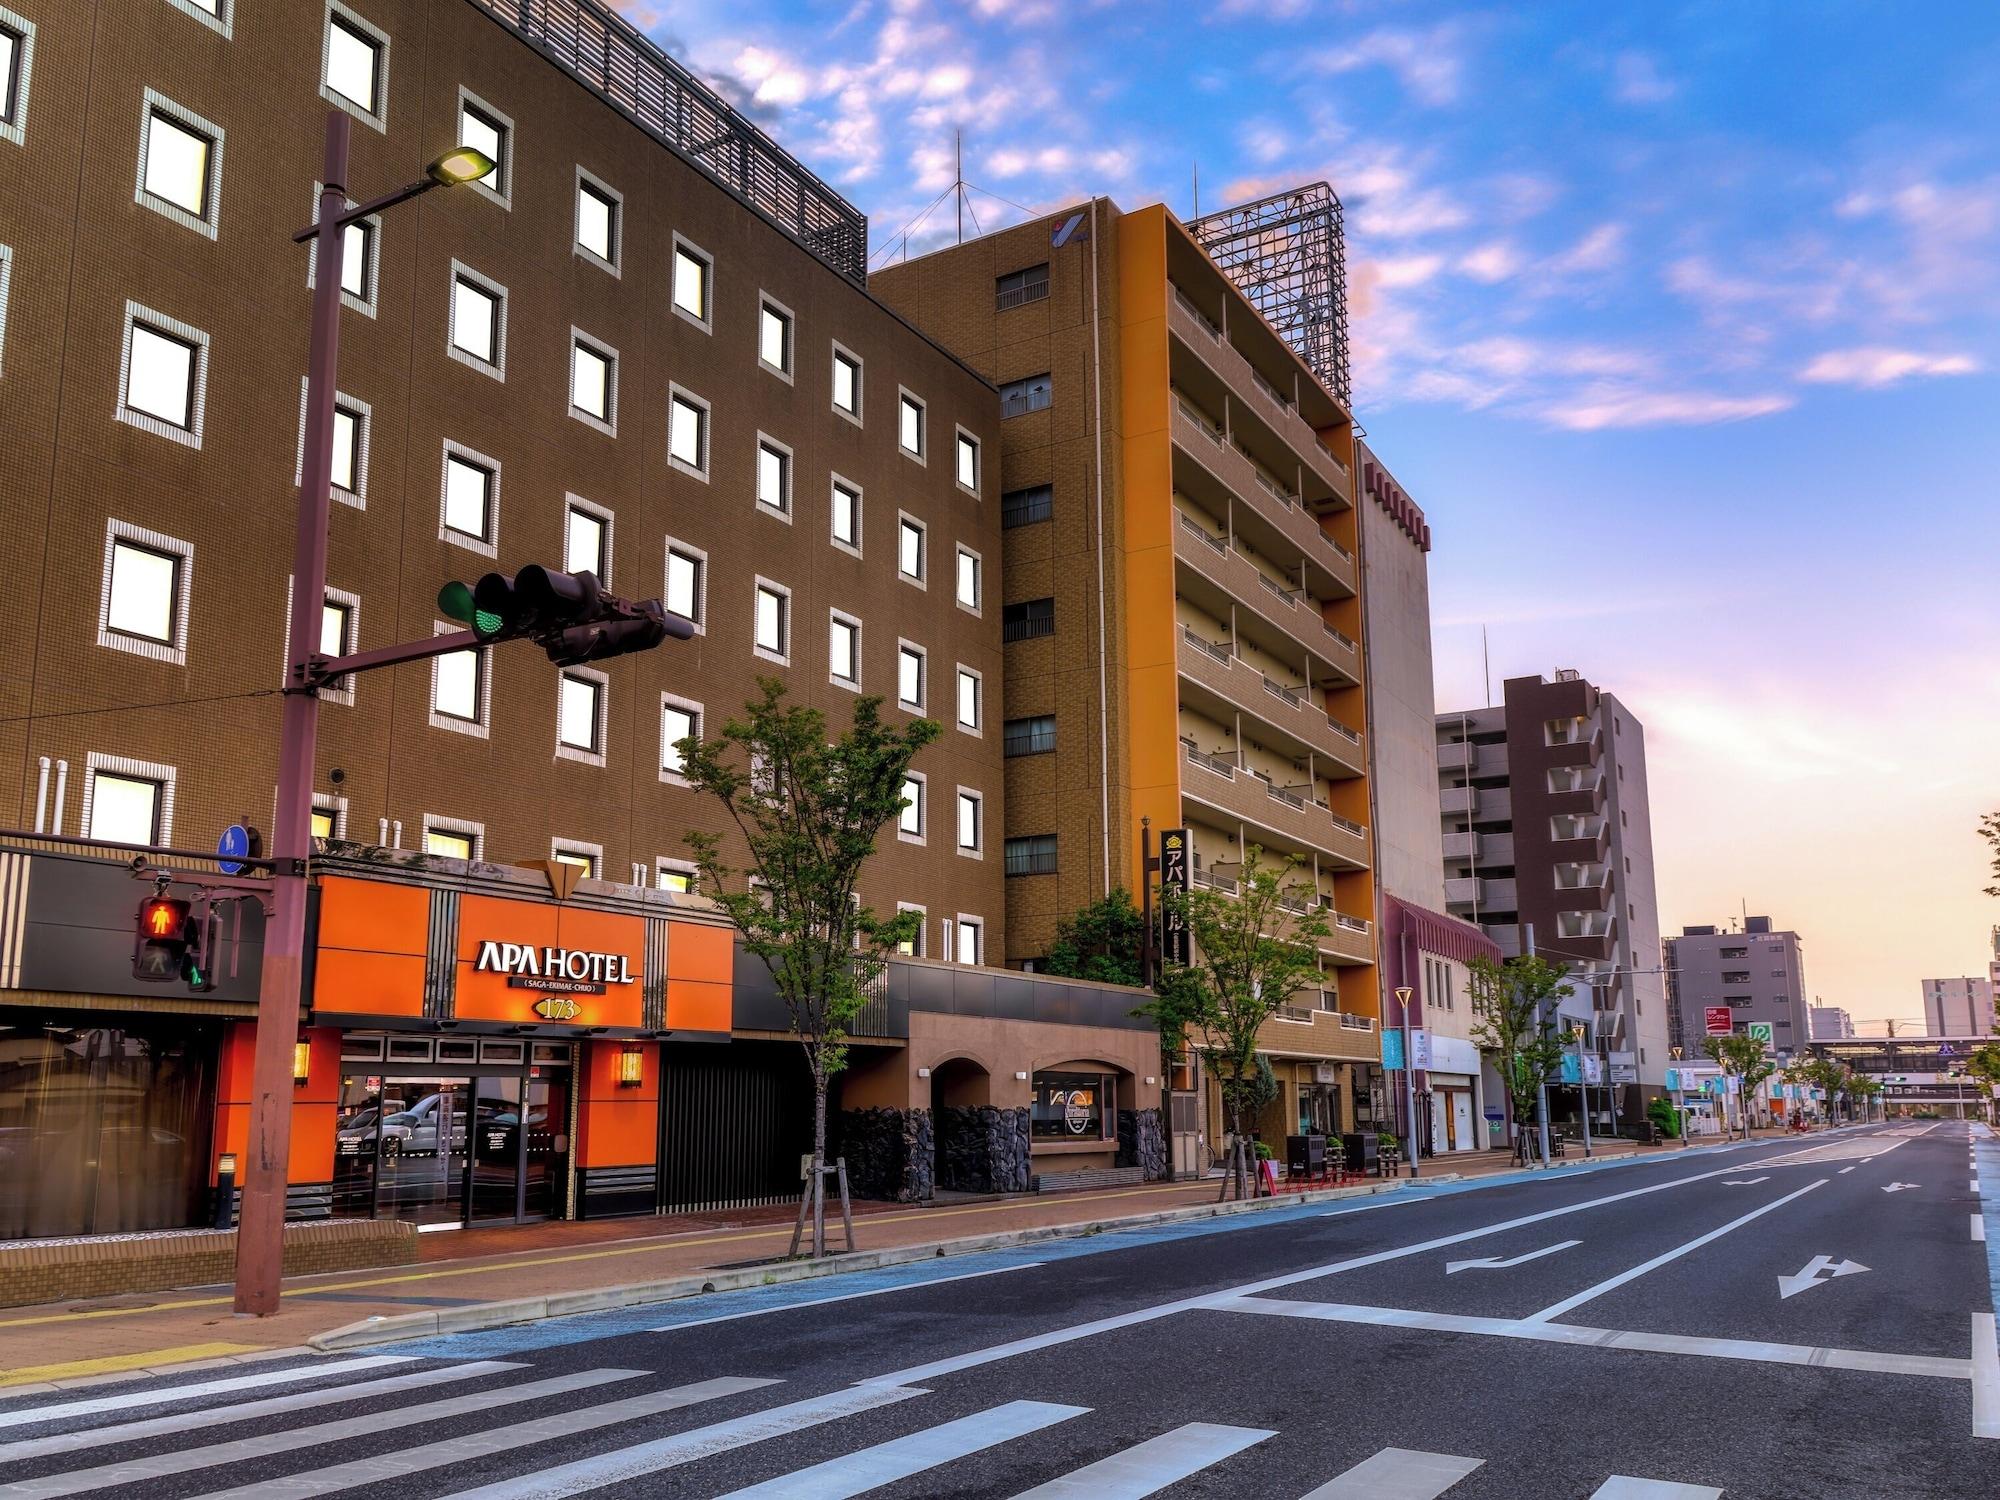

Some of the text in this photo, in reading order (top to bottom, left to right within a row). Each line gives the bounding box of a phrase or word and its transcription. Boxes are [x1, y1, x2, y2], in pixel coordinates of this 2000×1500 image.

[478, 941, 635, 983] APA HOTEL
[544, 998, 575, 1019] 173
